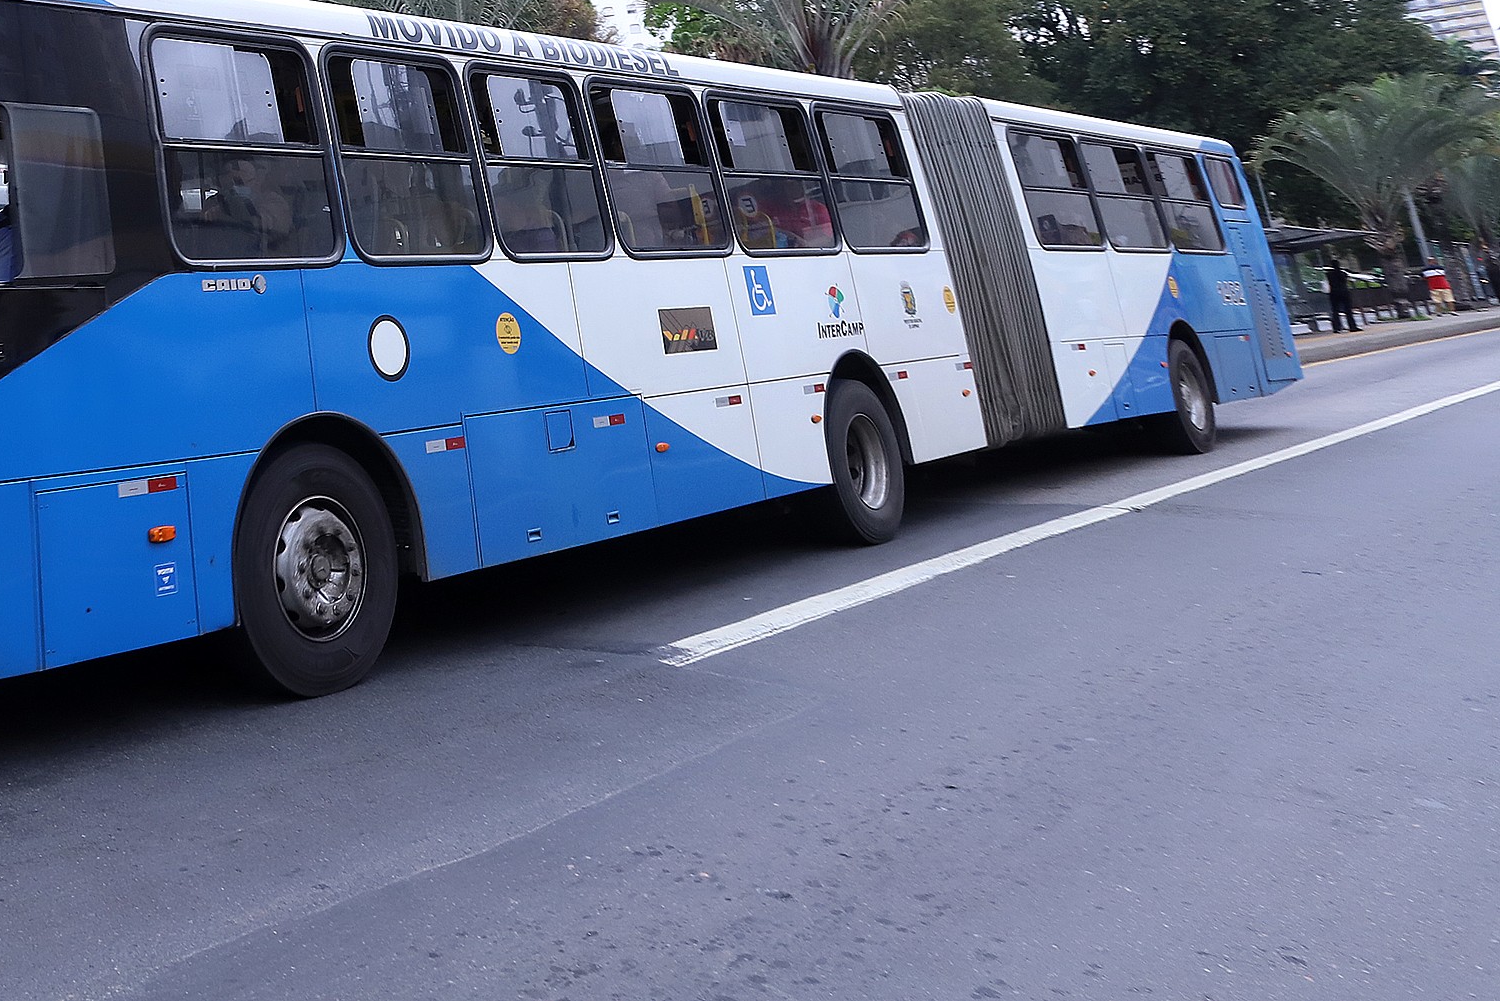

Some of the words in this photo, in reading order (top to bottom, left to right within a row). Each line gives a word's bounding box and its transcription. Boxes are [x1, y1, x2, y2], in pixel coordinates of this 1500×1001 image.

[366, 12, 501, 52] MOVIDO
[511, 31, 534, 58] A
[534, 35, 681, 77] BIODIESEL
[202, 278, 251, 291] CAIO
